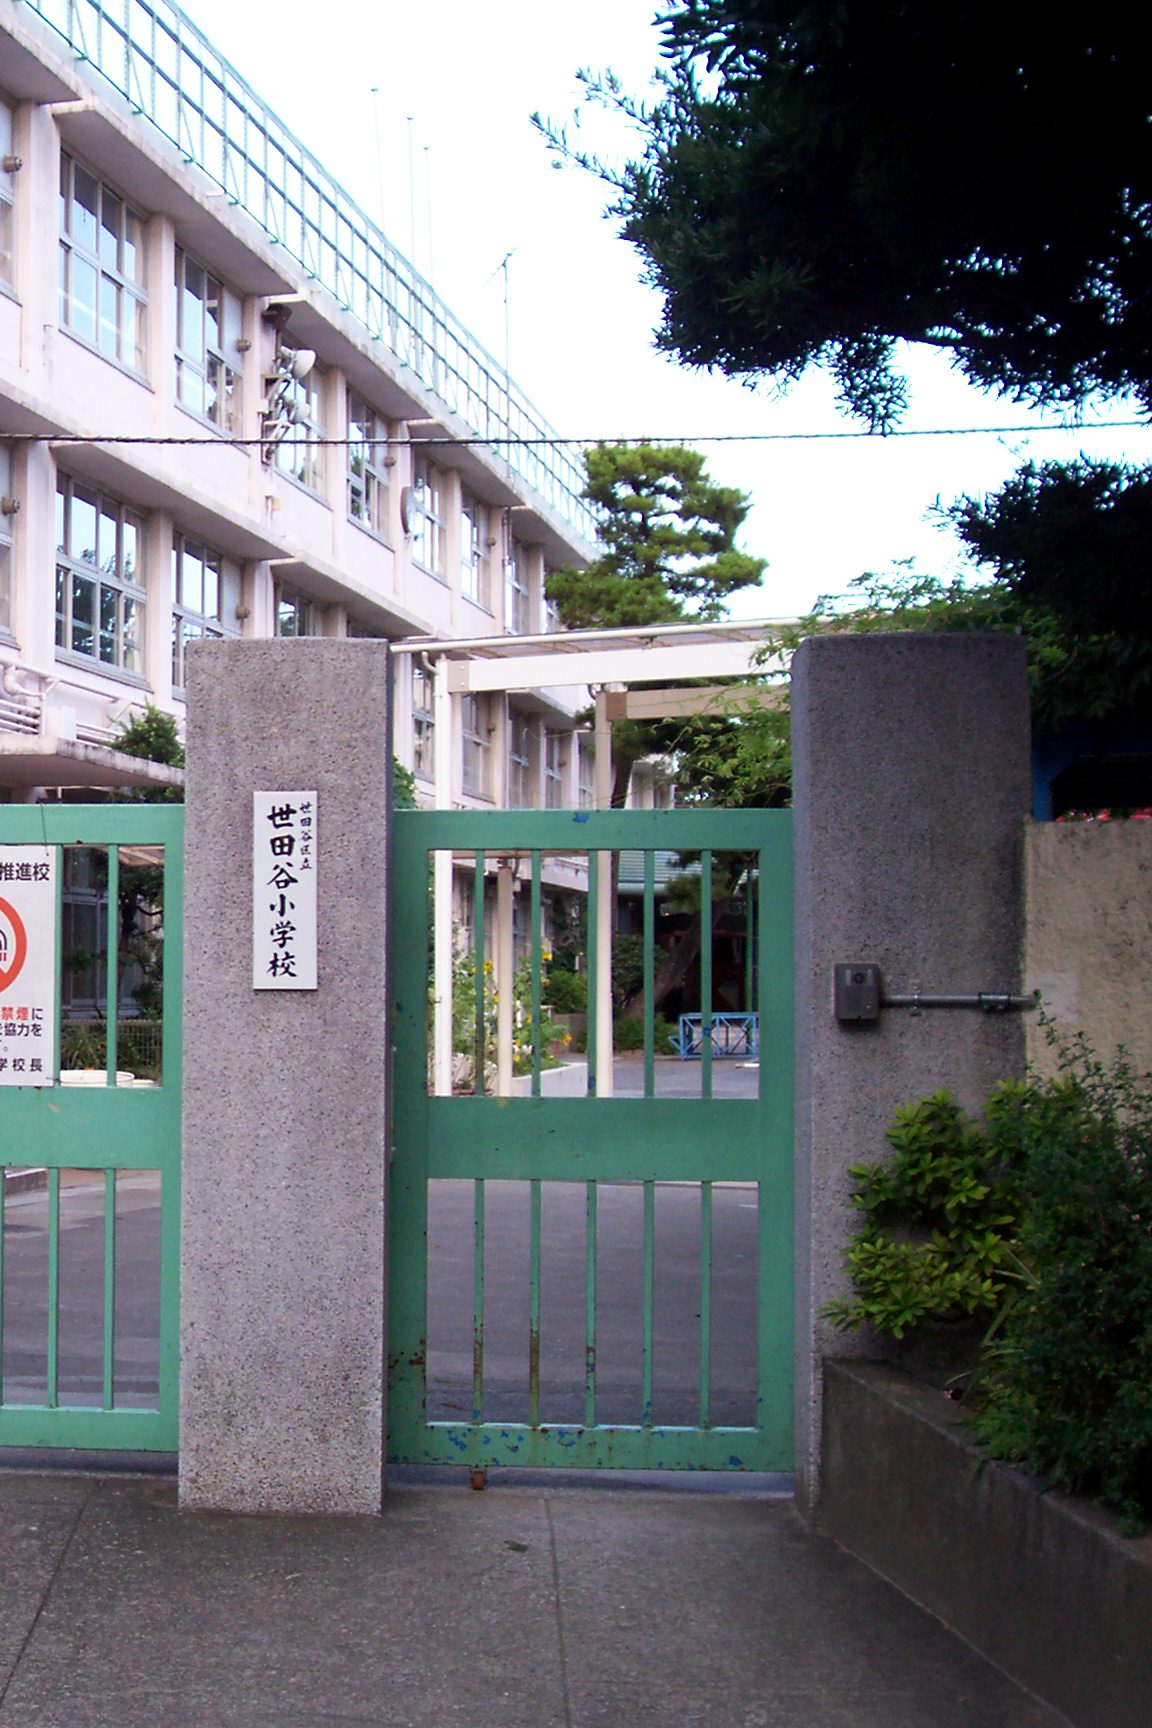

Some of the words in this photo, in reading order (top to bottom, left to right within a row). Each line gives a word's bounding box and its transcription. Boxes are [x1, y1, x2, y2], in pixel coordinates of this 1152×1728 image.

[266, 803, 299, 977] 世田谷小学校
